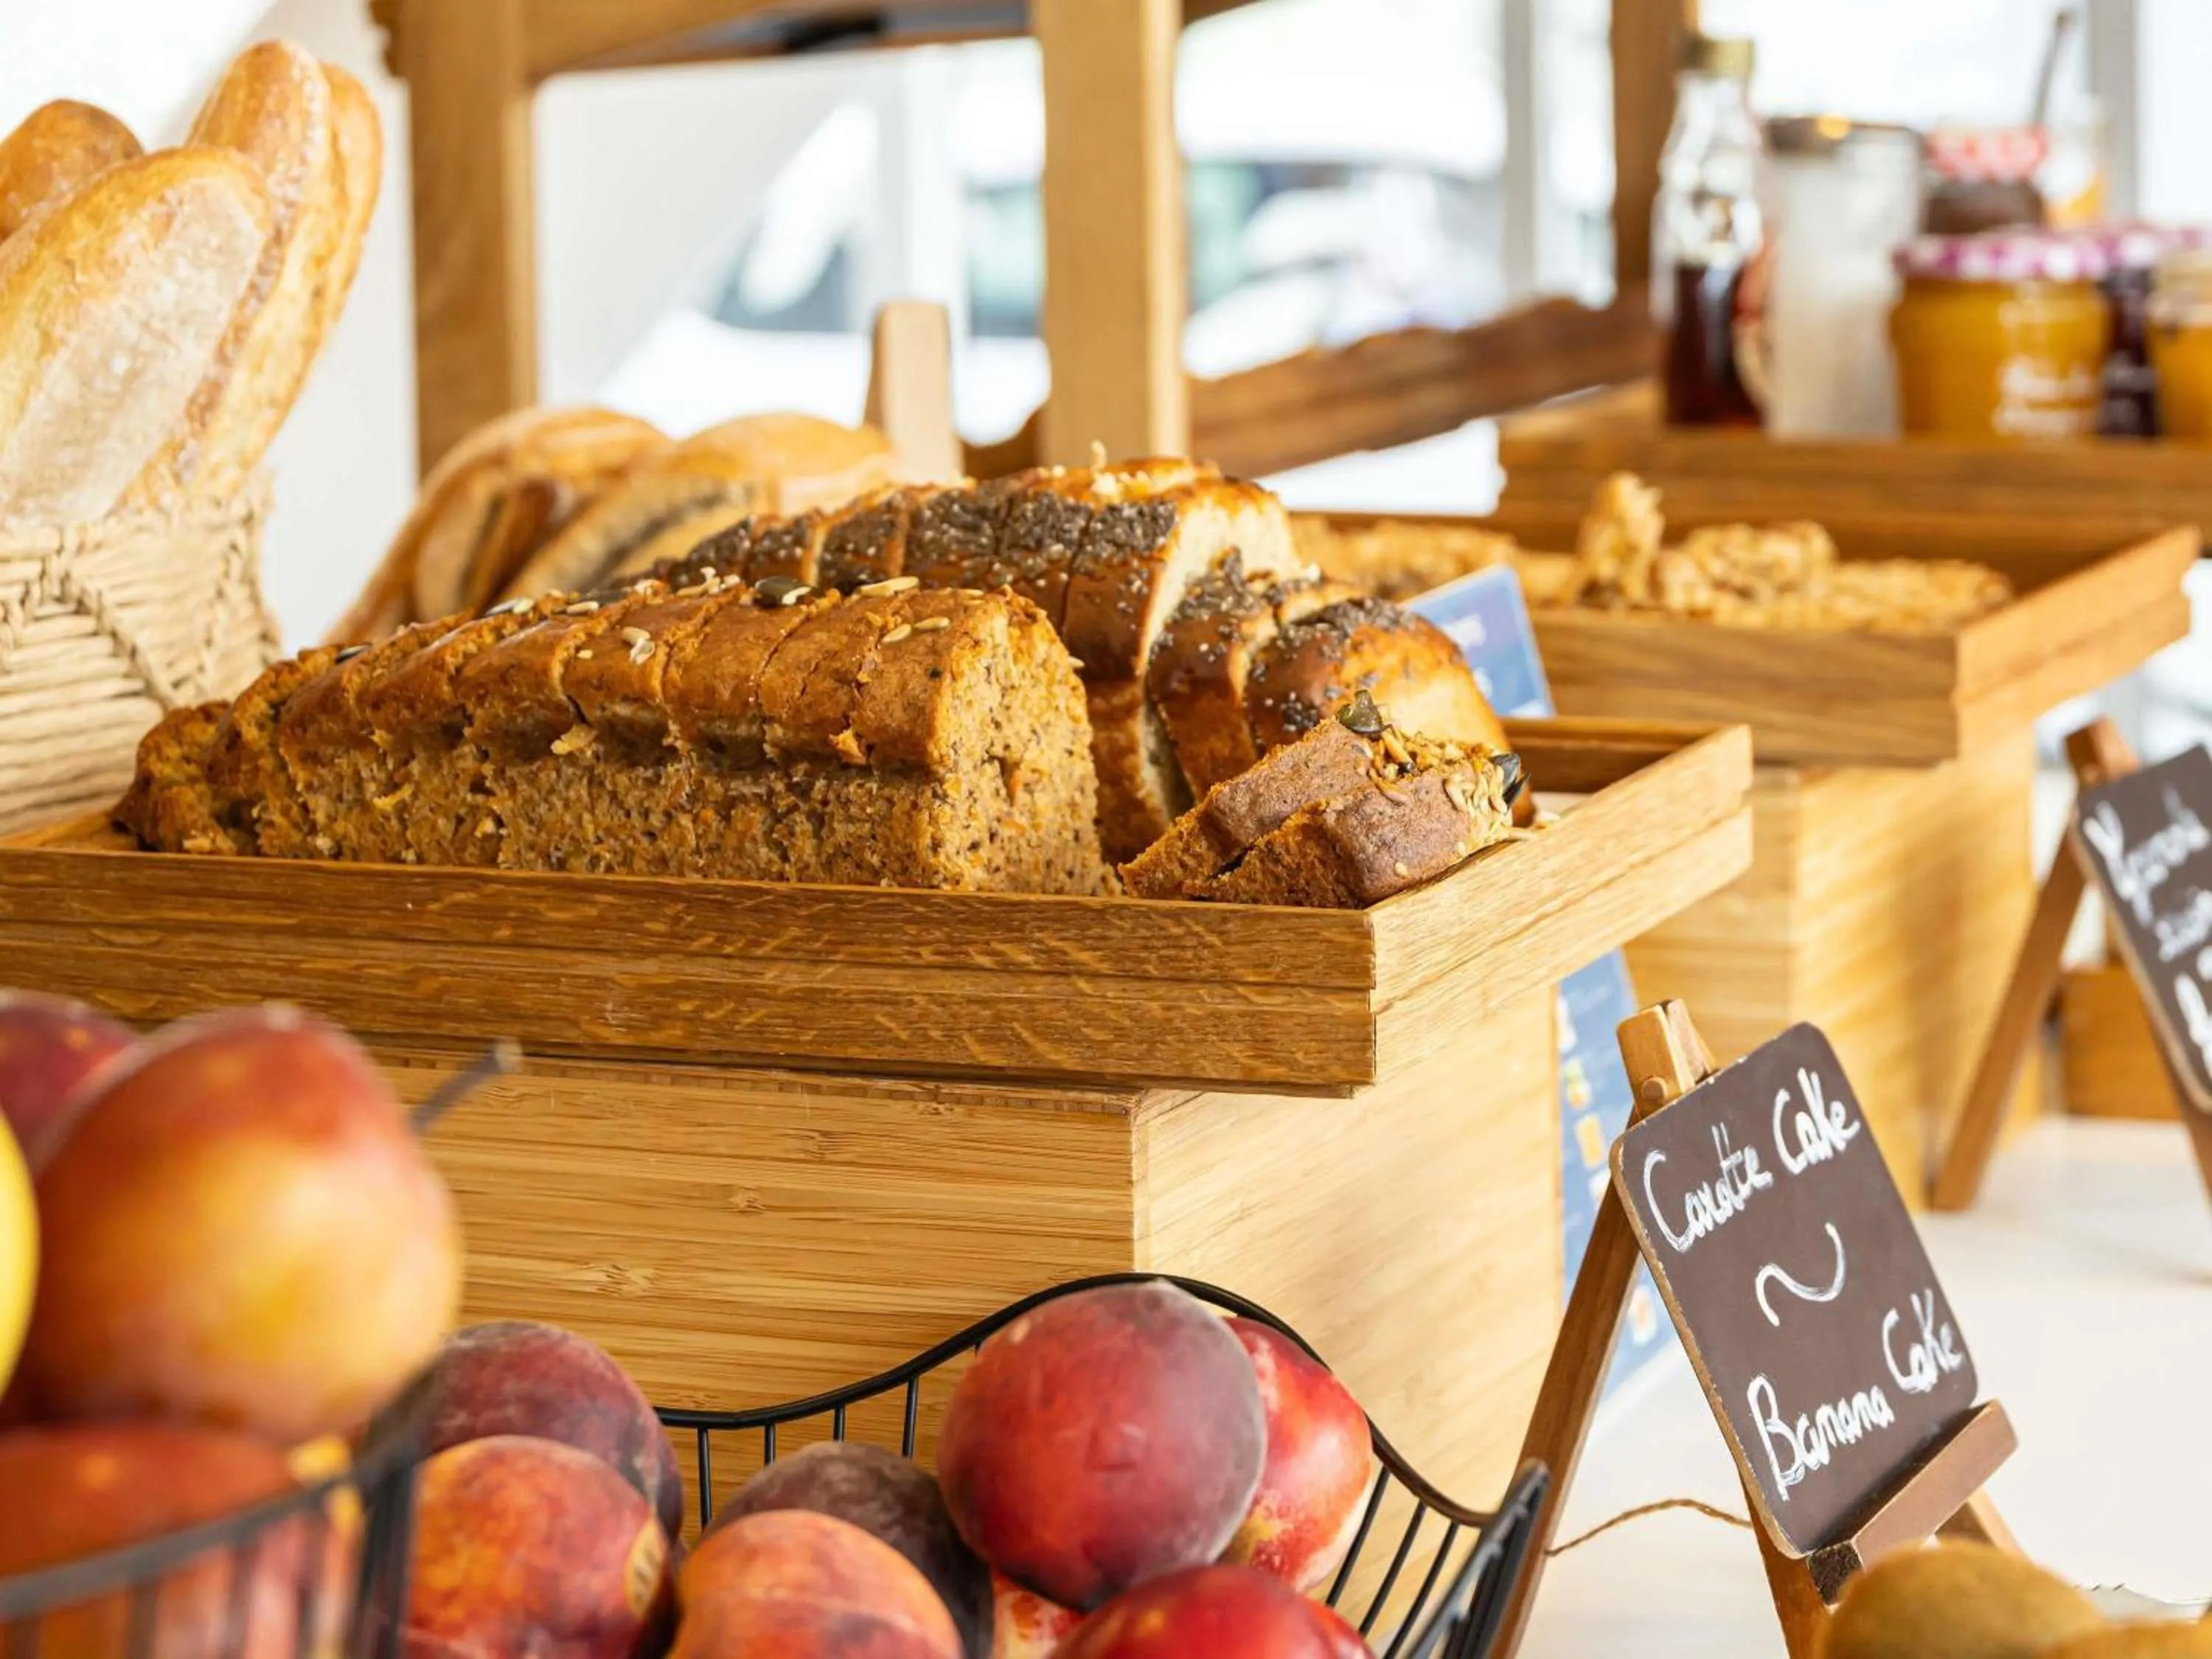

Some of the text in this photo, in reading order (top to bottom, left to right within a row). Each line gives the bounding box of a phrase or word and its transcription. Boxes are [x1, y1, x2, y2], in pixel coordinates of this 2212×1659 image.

[1773, 1067, 1860, 1175] Cake
[1747, 1287, 1964, 1501] Banana Cake
